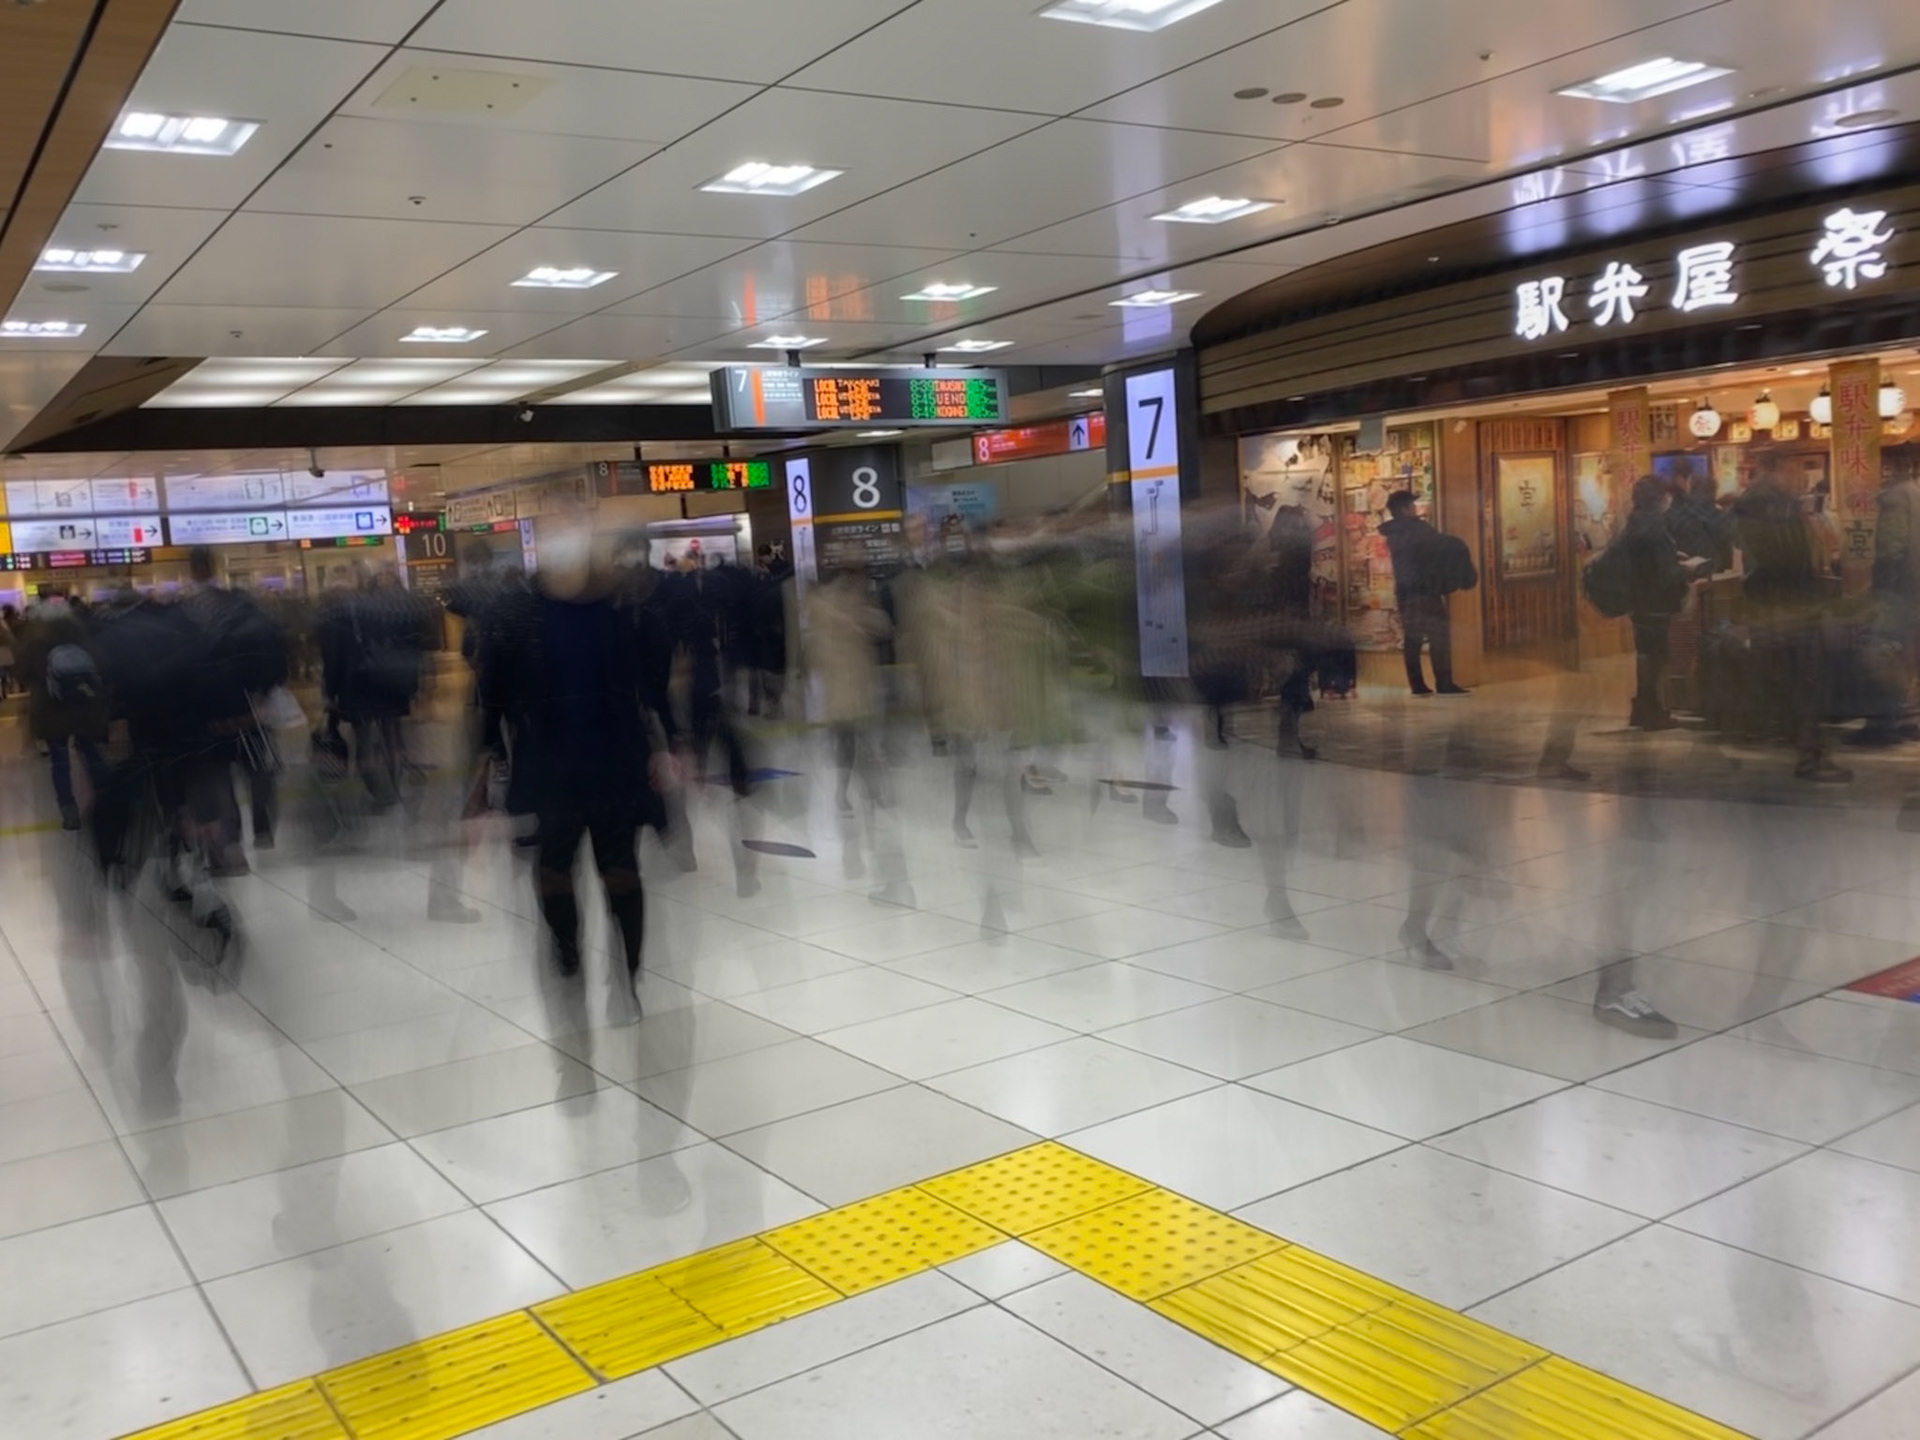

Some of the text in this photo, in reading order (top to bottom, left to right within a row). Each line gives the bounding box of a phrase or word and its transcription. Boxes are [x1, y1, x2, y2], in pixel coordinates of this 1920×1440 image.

[1515, 207, 1894, 341] 駅弁屋 祭
[735, 370, 747, 392] 7
[936, 392, 966, 405] UENO
[1138, 397, 1164, 460] 7
[979, 437, 989, 461] 8
[599, 462, 608, 476] 8
[793, 474, 807, 513] 8
[852, 467, 880, 508] 8
[422, 534, 446, 557] 10
